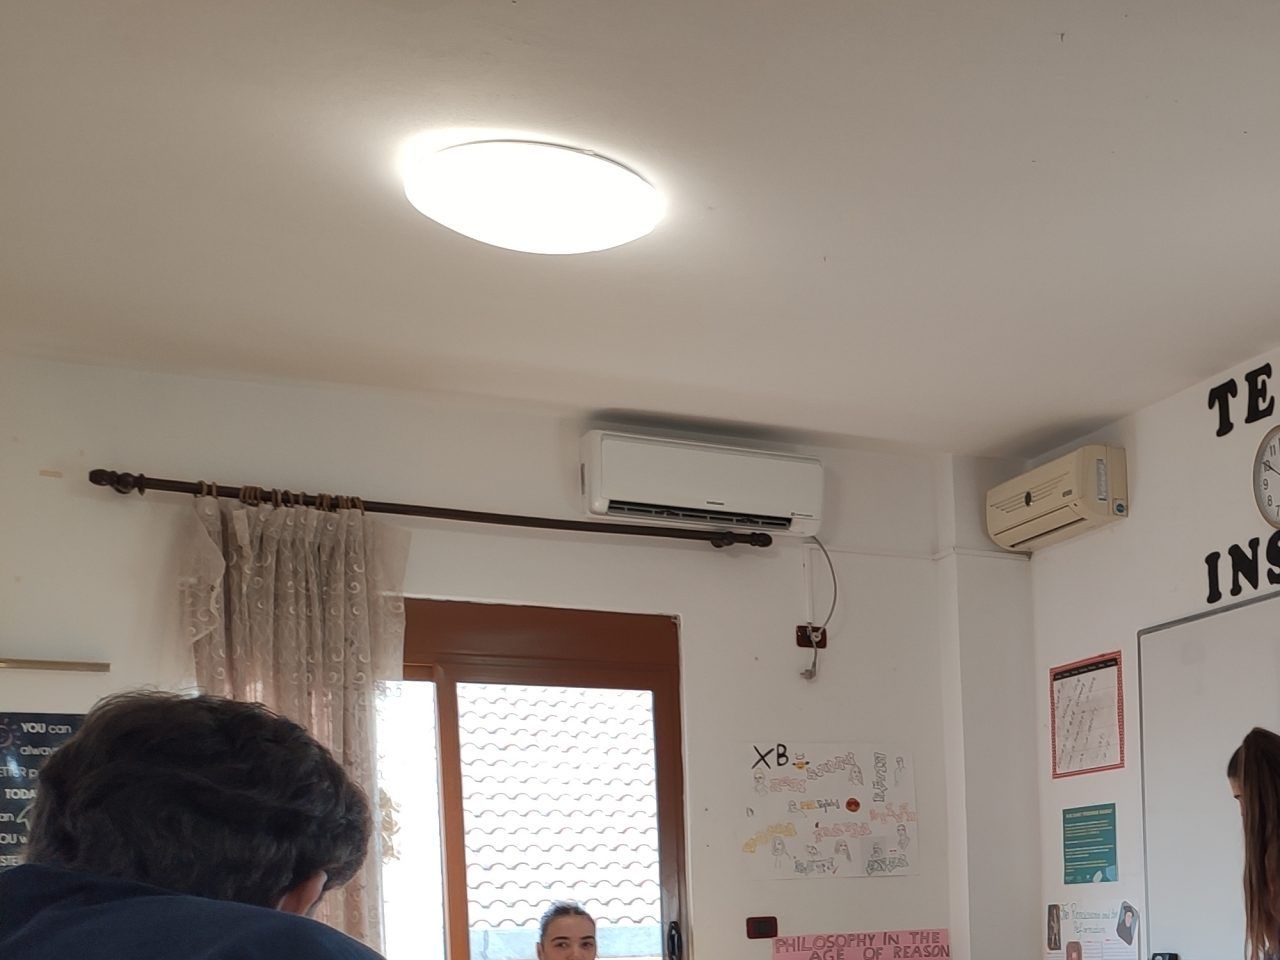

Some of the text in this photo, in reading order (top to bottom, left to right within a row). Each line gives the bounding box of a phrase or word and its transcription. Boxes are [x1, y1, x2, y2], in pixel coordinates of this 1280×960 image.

[1269, 445, 1276, 457] 11
[1263, 478, 1269, 491] 9
[1267, 494, 1273, 507] 8
[1275, 504, 1280, 518] 7
[21, 722, 72, 734] YOU can
[20, 745, 59, 756] alway
[4, 788, 37, 800] TODA
[0, 833, 17, 844] OU
[775, 931, 940, 954] PHILOSOPHY IN THE
[863, 946, 884, 960] OF
[893, 944, 951, 959] REASON
